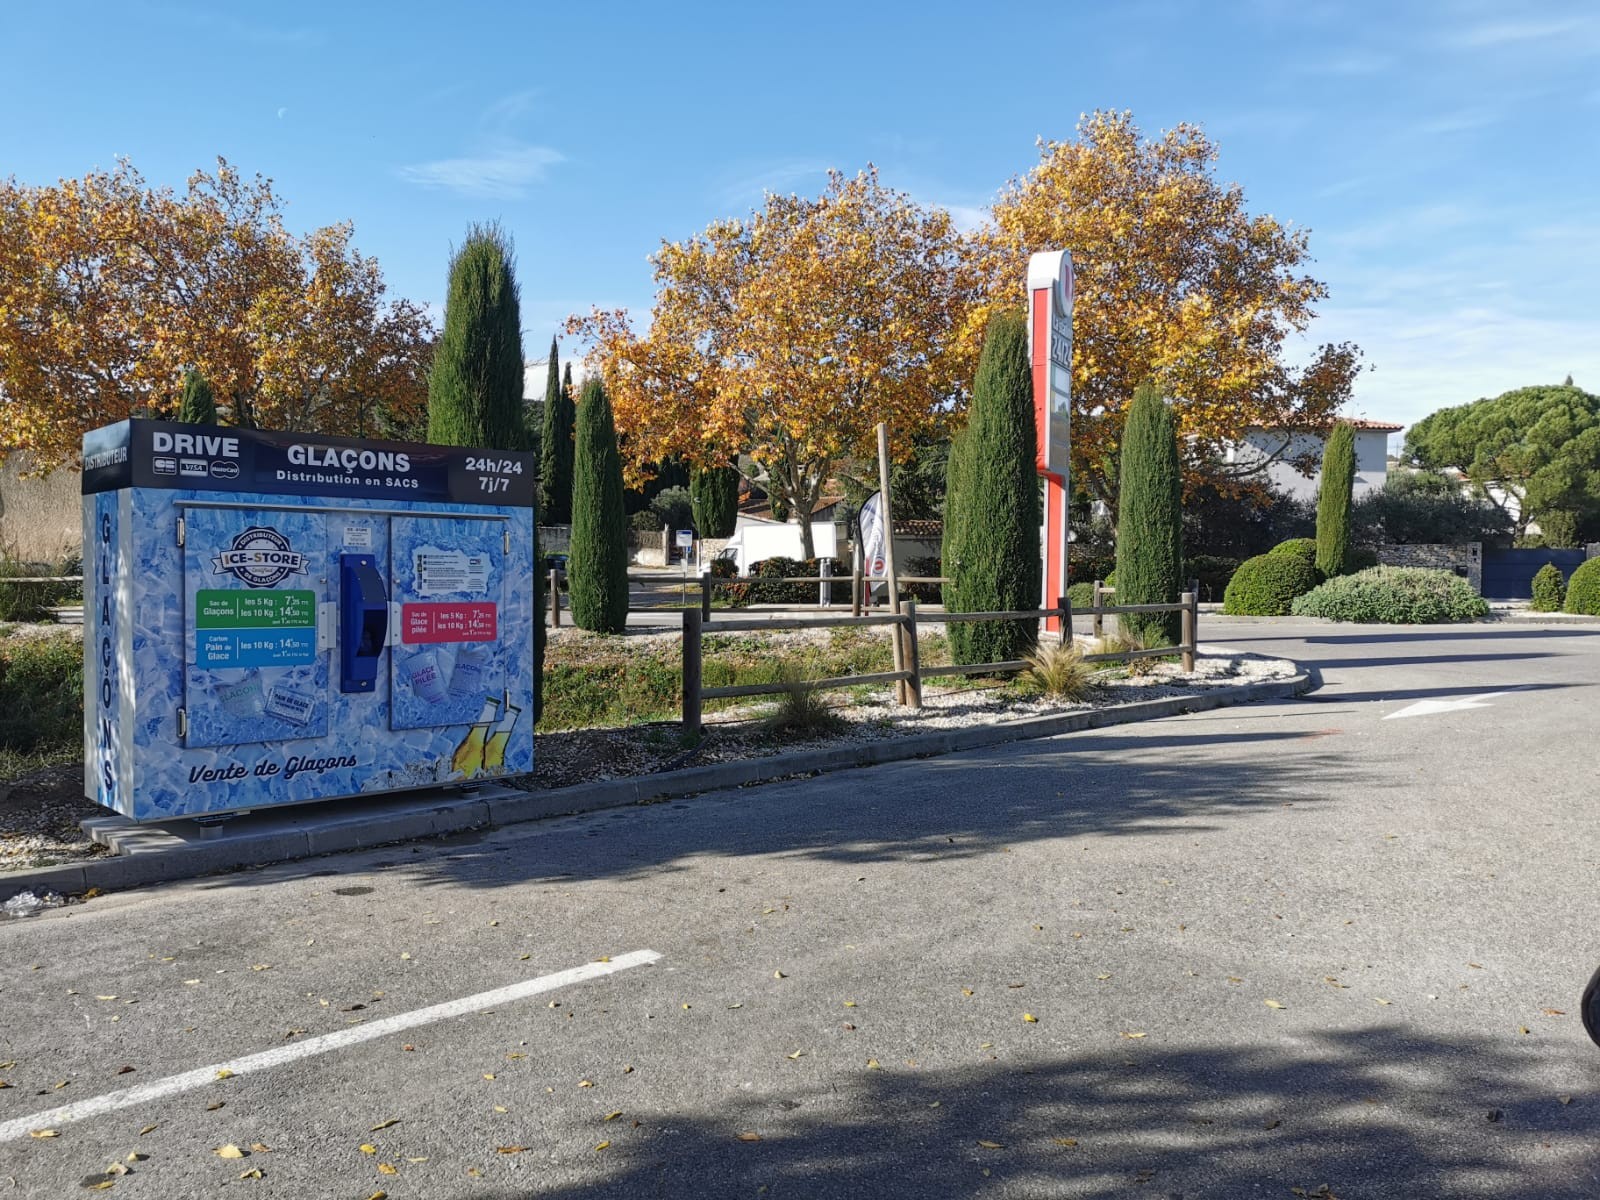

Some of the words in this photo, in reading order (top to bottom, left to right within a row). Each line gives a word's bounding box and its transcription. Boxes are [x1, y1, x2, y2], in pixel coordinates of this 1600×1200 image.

[152, 432, 240, 458] DRIVE
[84, 447, 128, 471] DISTRIBUTEUR
[287, 444, 411, 473] GLAÇONS
[465, 457, 522, 474] 24h/24
[276, 470, 360, 485] Distribution
[365, 478, 380, 487] en
[386, 476, 418, 488] SACS
[478, 476, 510, 493] 7j/7
[224, 552, 300, 566] ICE-STORE
[264, 598, 273, 606] Kg
[203, 608, 234, 617] Glaçons
[264, 609, 274, 617] Kg
[205, 643, 222, 651] Pain
[264, 642, 274, 650] Kg
[208, 652, 230, 660] Glace
[189, 763, 249, 783] Vente
[254, 760, 280, 776] de
[284, 754, 357, 780] Glaçons
